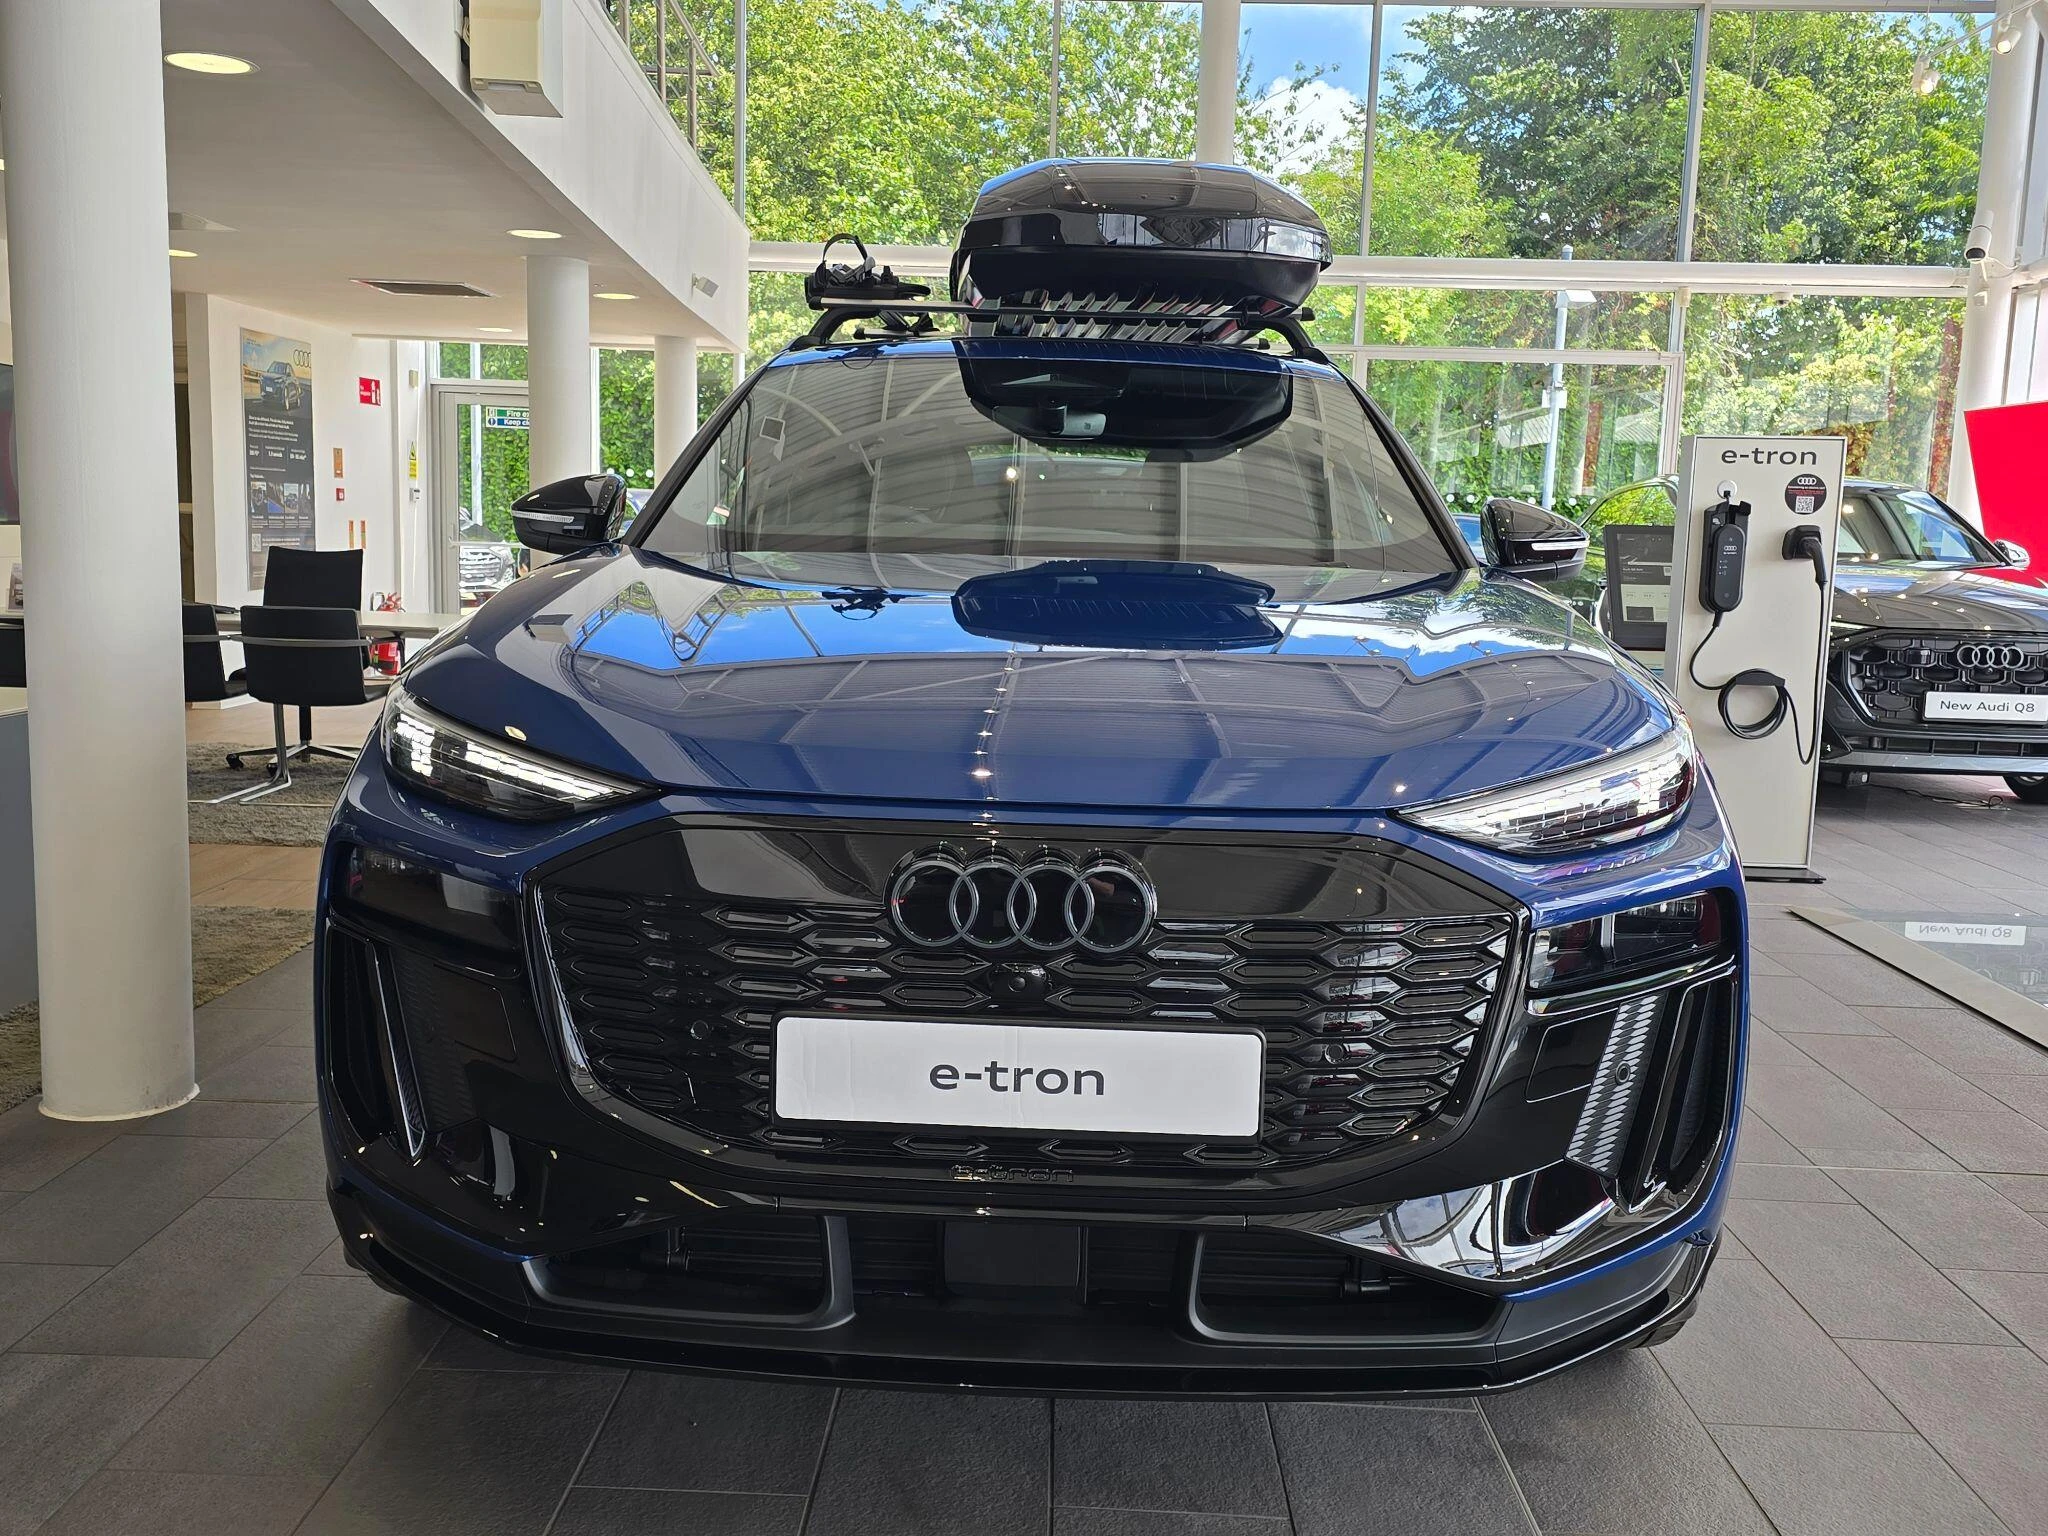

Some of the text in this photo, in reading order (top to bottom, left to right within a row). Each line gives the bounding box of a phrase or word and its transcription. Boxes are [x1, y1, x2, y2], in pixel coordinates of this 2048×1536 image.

[1721, 447, 1817, 465] e-tron
[1940, 700, 2035, 714] New Audi Q8
[929, 1060, 1105, 1096] e-tron
[951, 1164, 1074, 1183] e-tron
